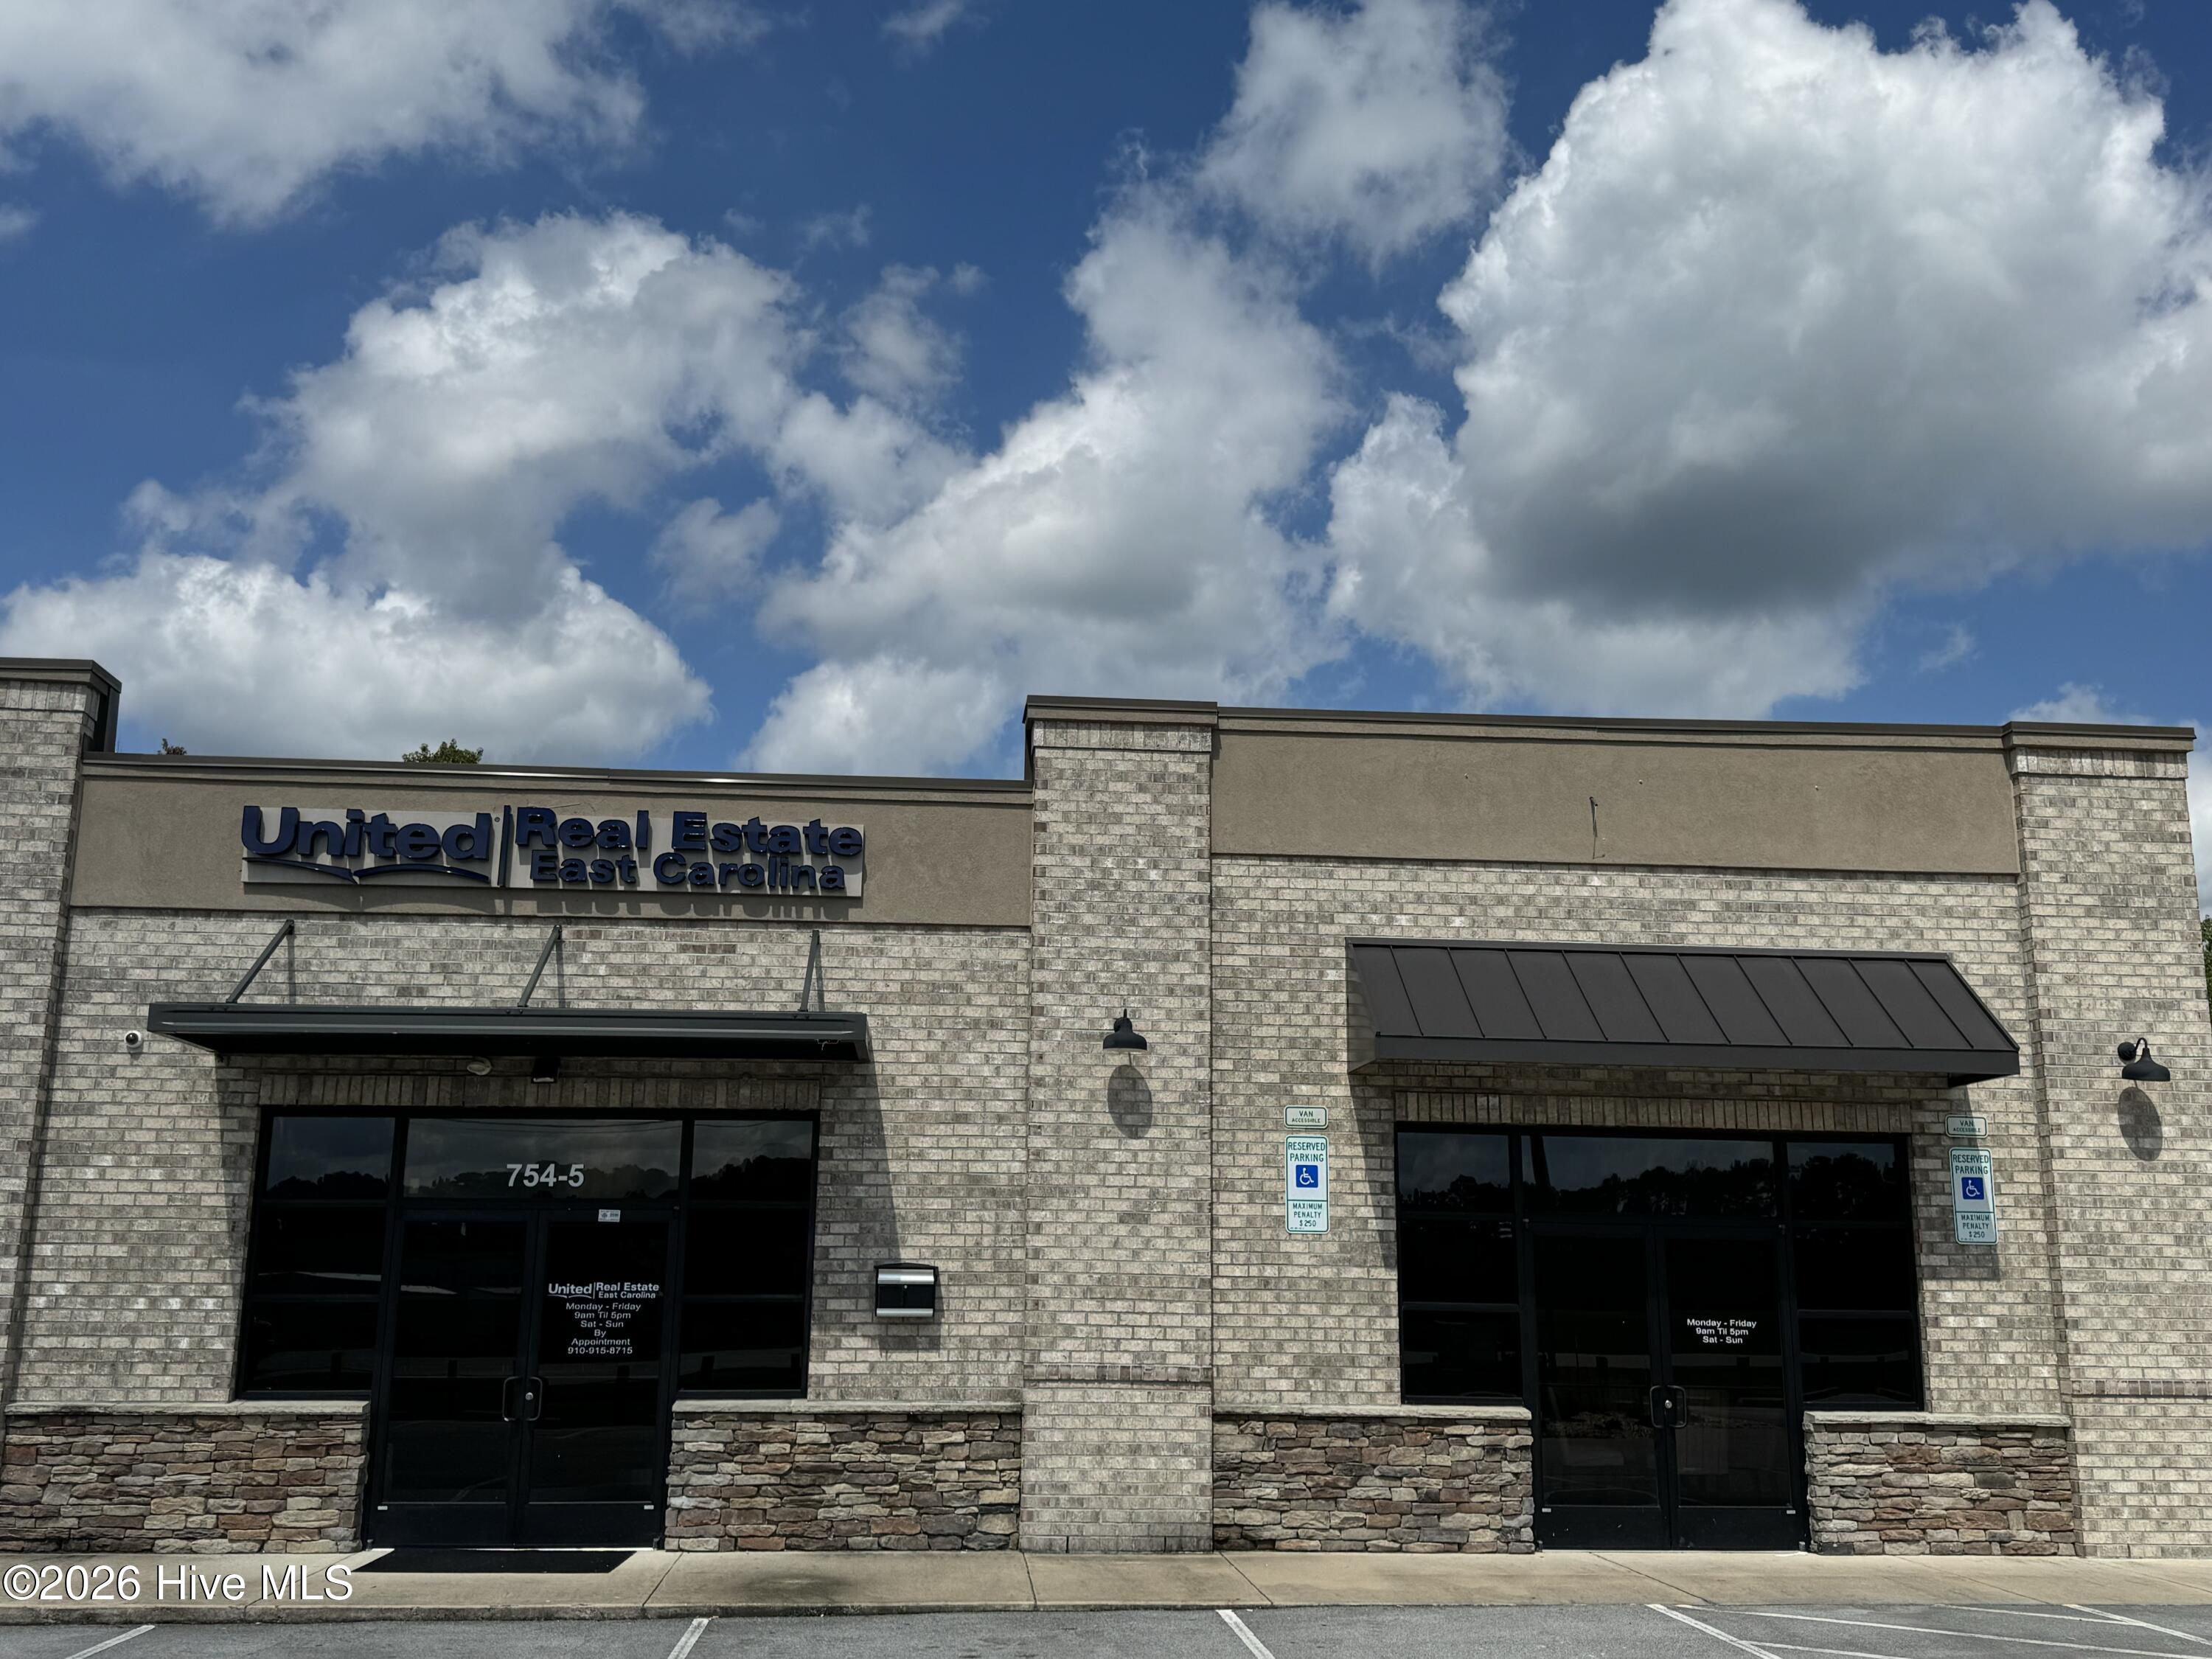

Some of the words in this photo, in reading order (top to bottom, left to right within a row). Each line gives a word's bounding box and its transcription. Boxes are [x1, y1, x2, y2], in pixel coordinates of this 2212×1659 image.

[241, 805, 492, 860] United
[515, 807, 649, 850] Real
[671, 811, 863, 858] Estate
[531, 849, 638, 886] East
[653, 852, 846, 891] Carolina
[1288, 1142, 1325, 1151] RESERVED
[1290, 1153, 1324, 1162] PARKING
[1953, 1154, 1989, 1164] RESERVED
[1955, 1166, 1989, 1175] PARKING
[506, 1164, 585, 1187] 754-5
[548, 1283, 592, 1294] United
[596, 1282, 621, 1291] Real
[624, 1282, 660, 1291] Estate
[566, 1302, 604, 1311] Monday
[612, 1302, 641, 1311] Friday
[574, 1311, 595, 1319] 9am
[611, 1311, 631, 1320] 5pm
[580, 1320, 597, 1328] Sat
[1687, 1318, 1722, 1328] Monday
[1729, 1319, 1757, 1328] Friday
[594, 1329, 606, 1338] By
[571, 1338, 631, 1348] Appointment
[567, 1346, 633, 1355] 910-915-8715
